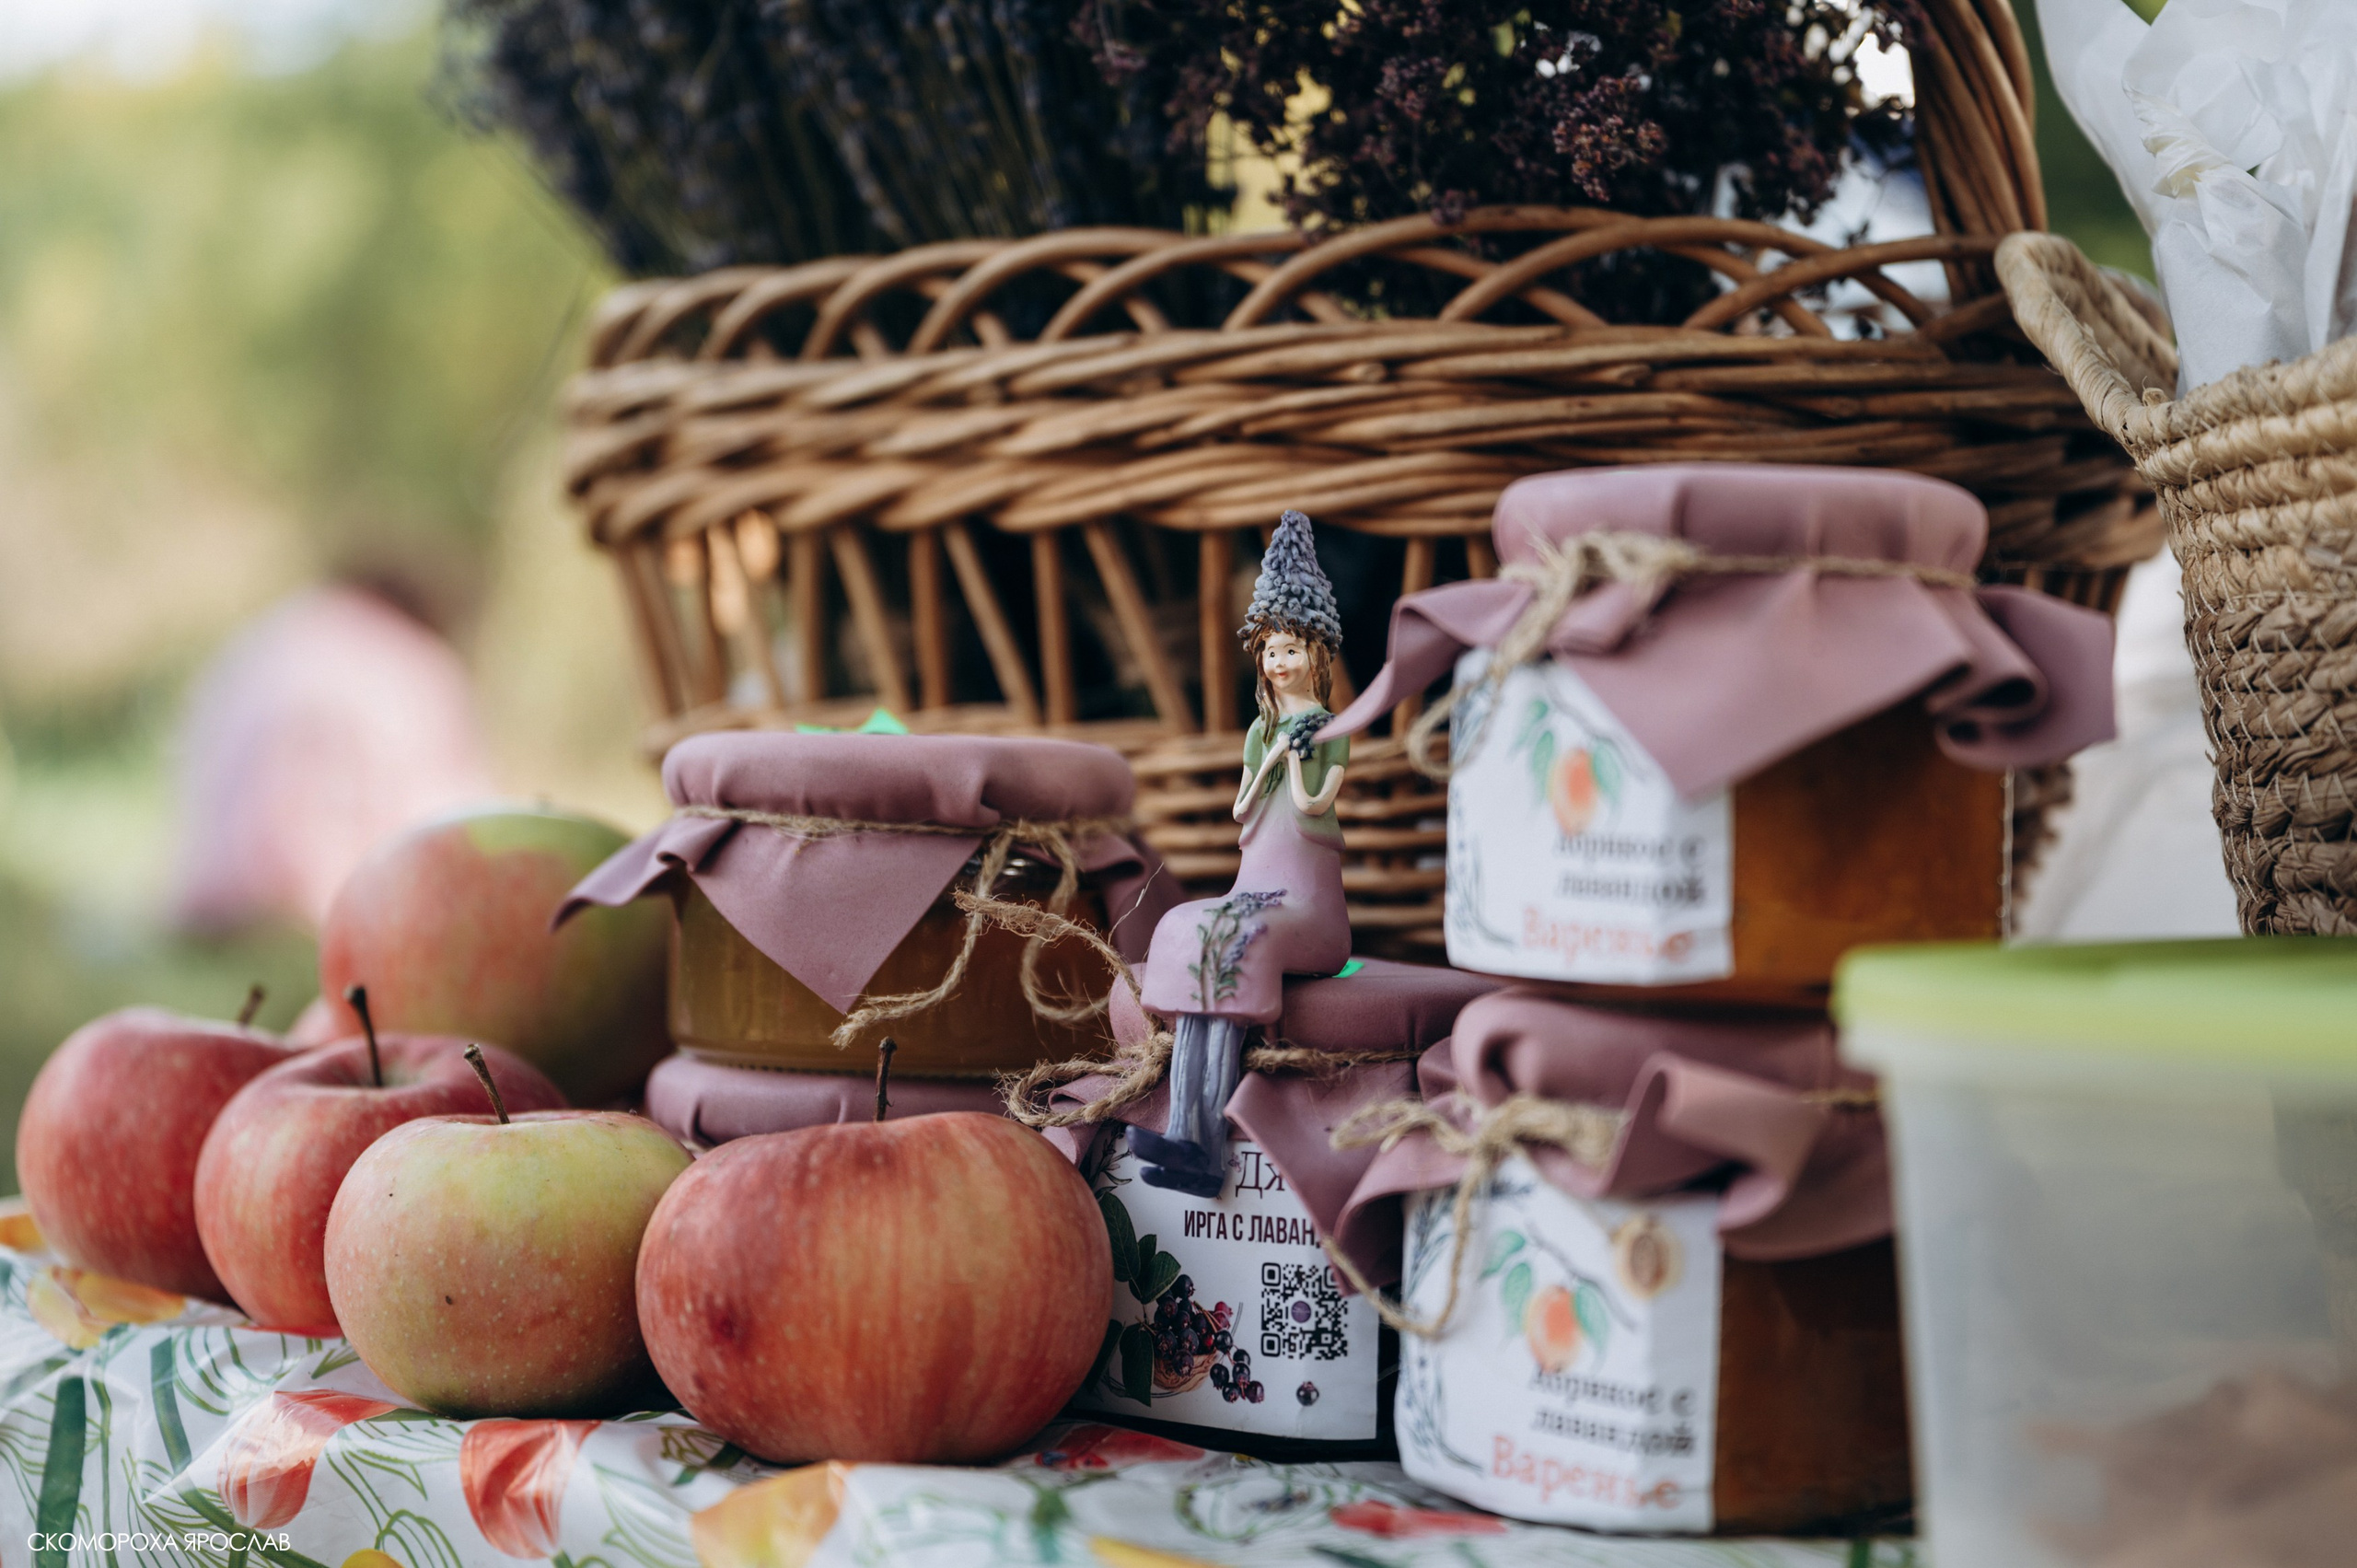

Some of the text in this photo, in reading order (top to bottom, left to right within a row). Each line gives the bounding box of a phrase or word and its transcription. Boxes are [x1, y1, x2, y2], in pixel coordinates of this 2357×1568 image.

[1236, 1151, 1285, 1199] Дж
[1185, 1210, 1320, 1249] ИРГА С ЛАВАН
[1492, 1435, 1681, 1510] Варенье
